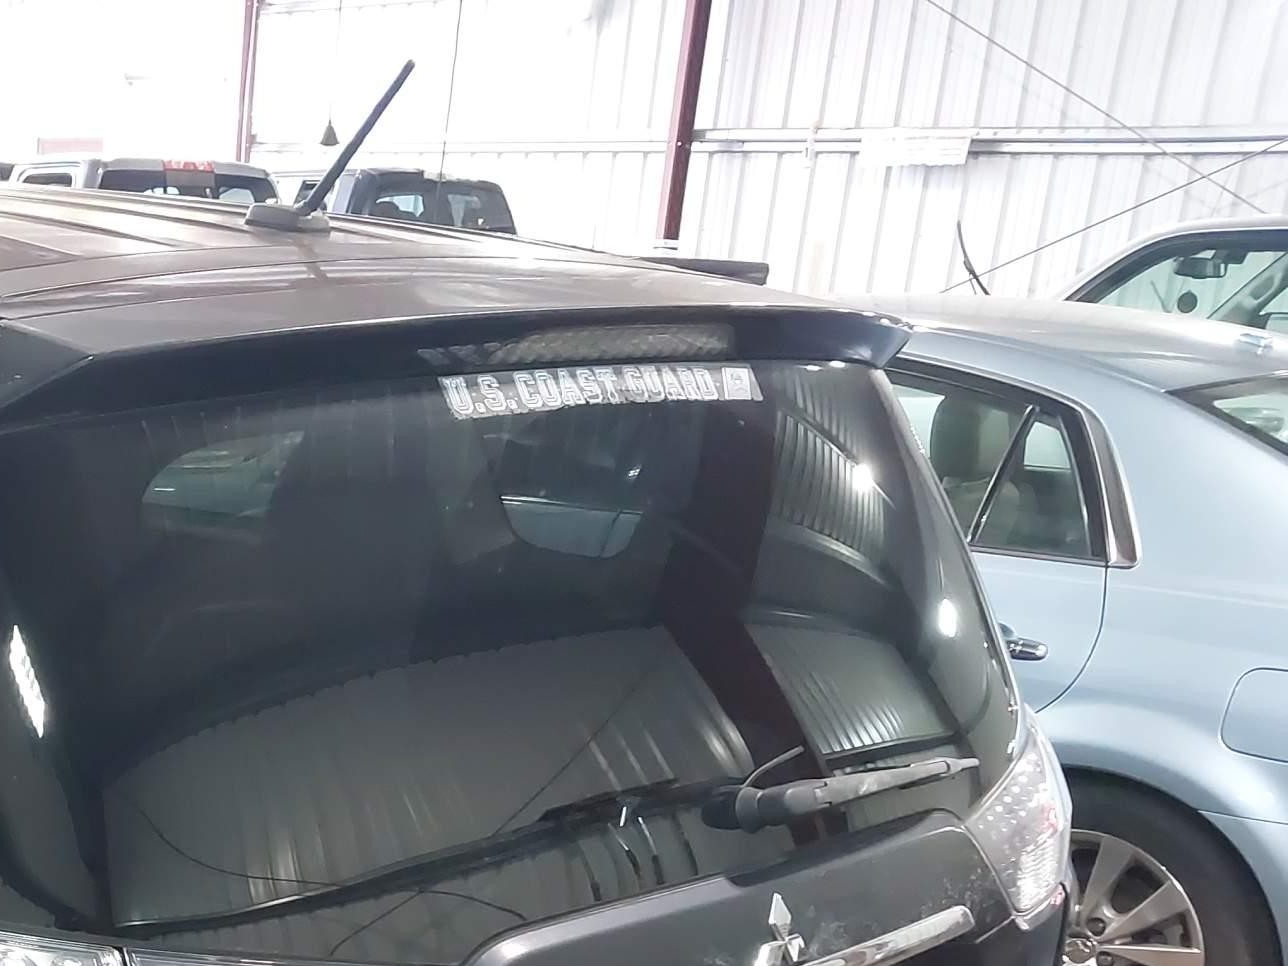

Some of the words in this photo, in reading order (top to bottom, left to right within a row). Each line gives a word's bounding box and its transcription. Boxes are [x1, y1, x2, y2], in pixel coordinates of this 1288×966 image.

[443, 374, 519, 415] U.S.
[514, 366, 617, 413] COAST
[624, 365, 719, 402] GUARD
